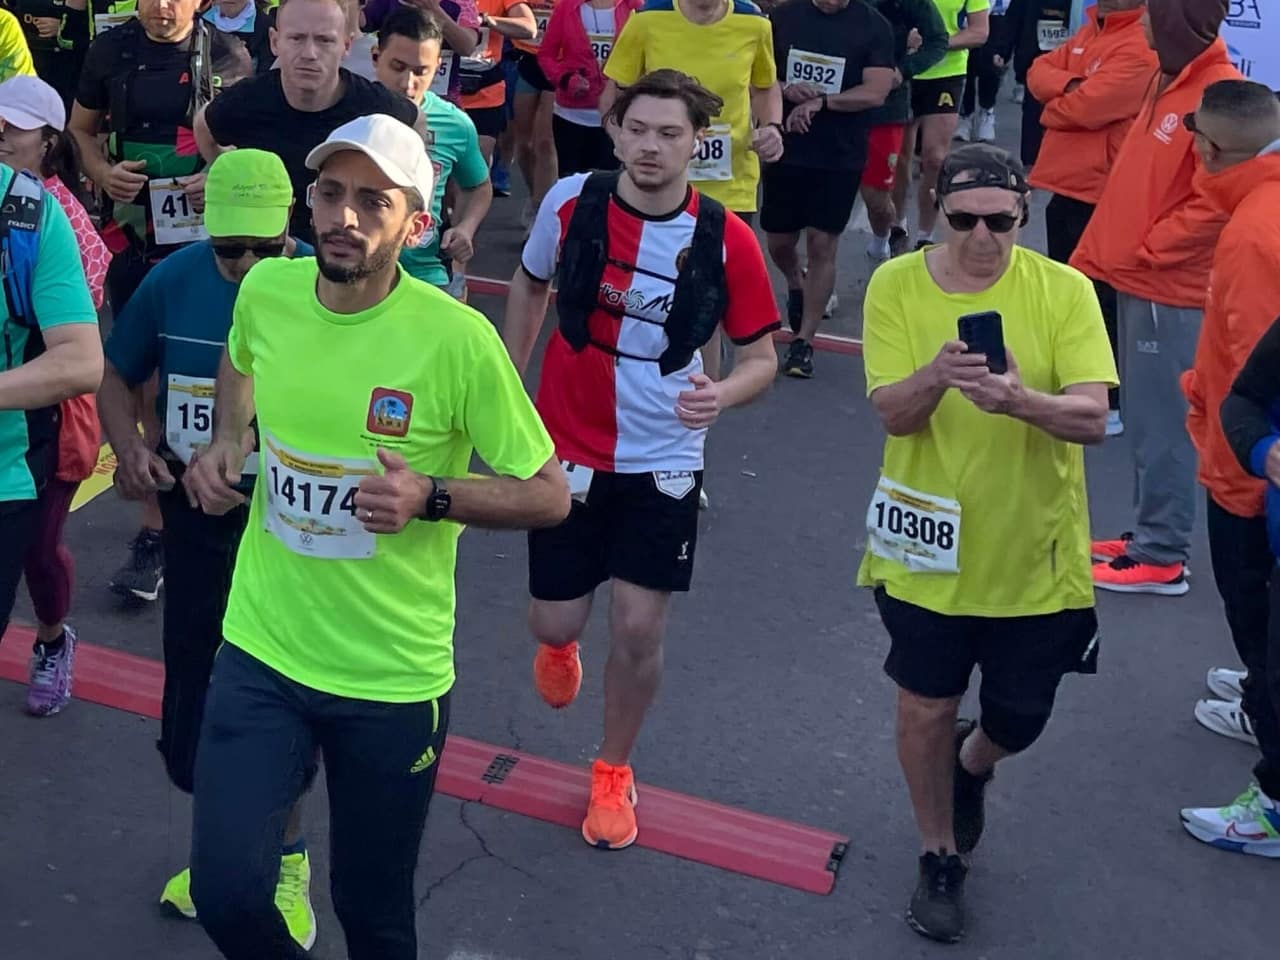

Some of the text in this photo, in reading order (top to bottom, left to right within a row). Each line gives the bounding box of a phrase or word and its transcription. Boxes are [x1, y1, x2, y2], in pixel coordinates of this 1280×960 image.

[793, 62, 836, 85] 9932
[270, 466, 358, 517] 14174
[875, 501, 955, 551] 10308
